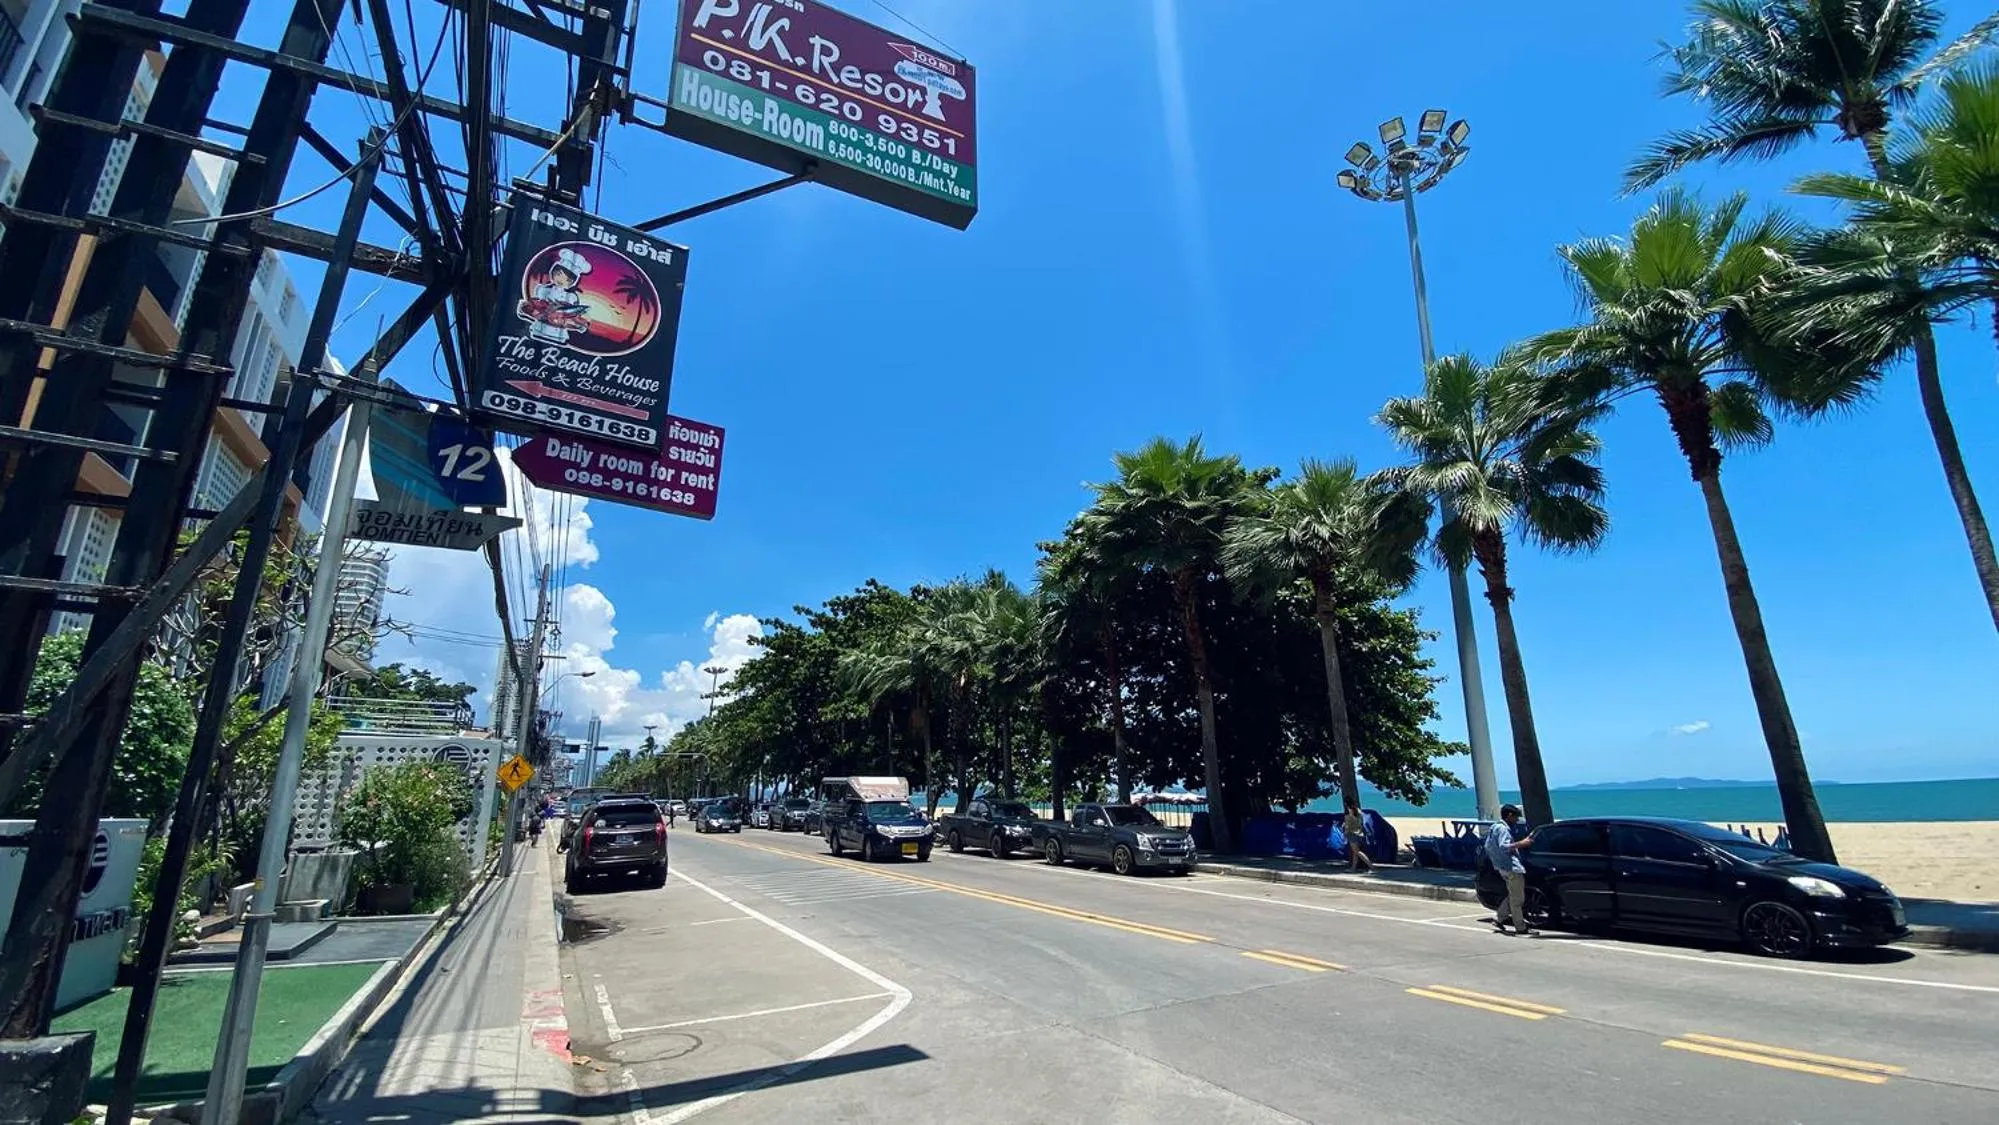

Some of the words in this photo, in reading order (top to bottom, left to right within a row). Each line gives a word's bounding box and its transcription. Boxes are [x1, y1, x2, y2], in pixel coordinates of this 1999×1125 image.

[680, 69, 825, 151] House-Room
[702, 50, 864, 122] 081-620
[877, 114, 956, 156] 9351
[829, 120, 906, 159] 800-3,500
[912, 149, 958, 179] B./Day
[588, 223, 618, 247] บีช
[496, 356, 548, 379] Foods
[551, 372, 572, 388] &
[576, 377, 658, 408] Beverages
[498, 335, 535, 360] The
[540, 346, 603, 378] Beach
[604, 363, 660, 392] House
[490, 394, 651, 442] 098-9161638
[437, 443, 491, 482] 12
[546, 437, 593, 468] Daily
[599, 454, 643, 476] room
[650, 461, 676, 482] for
[680, 471, 715, 491] rent
[668, 446, 715, 468] รายวัน
[564, 468, 696, 506] 098-9161638
[351, 525, 441, 545] JOMTIEN
[356, 508, 484, 537] จอมเทียน
